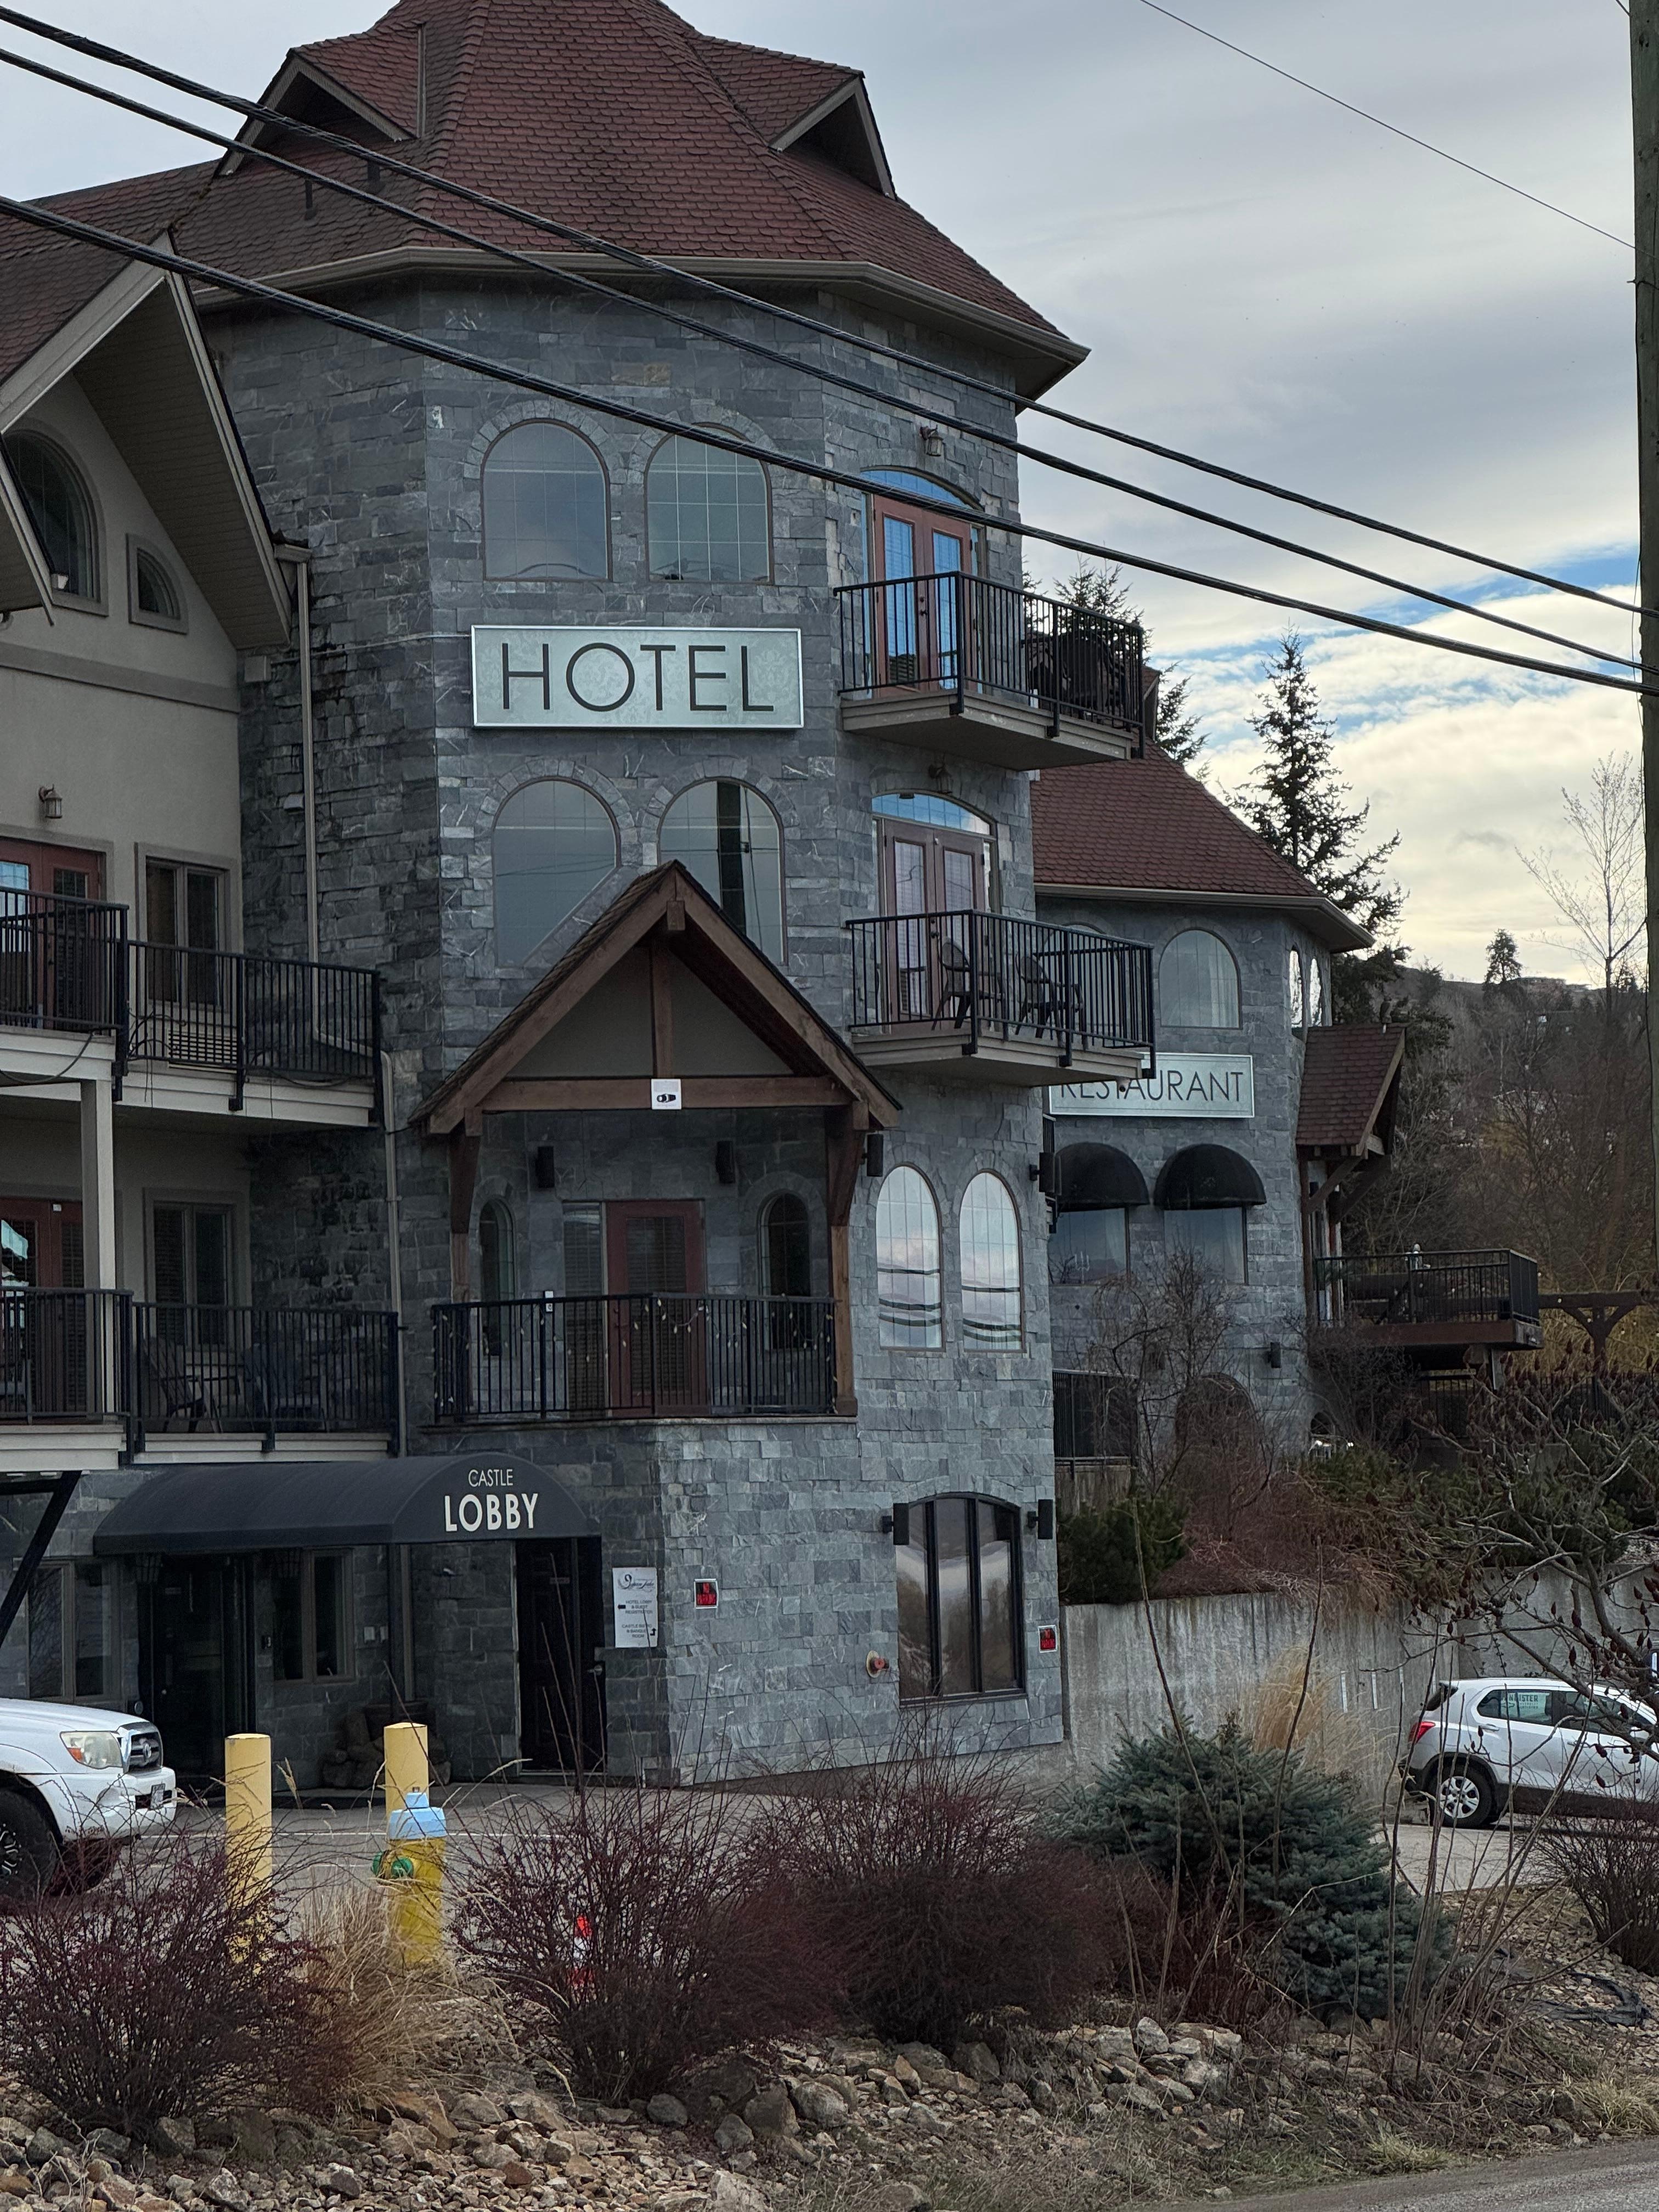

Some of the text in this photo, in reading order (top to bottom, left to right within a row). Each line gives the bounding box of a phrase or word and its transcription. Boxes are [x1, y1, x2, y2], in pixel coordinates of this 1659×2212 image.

[501, 642, 774, 712] HOTEL
[468, 1469, 514, 1488] CASTLE
[444, 1493, 539, 1532] LOBBY
